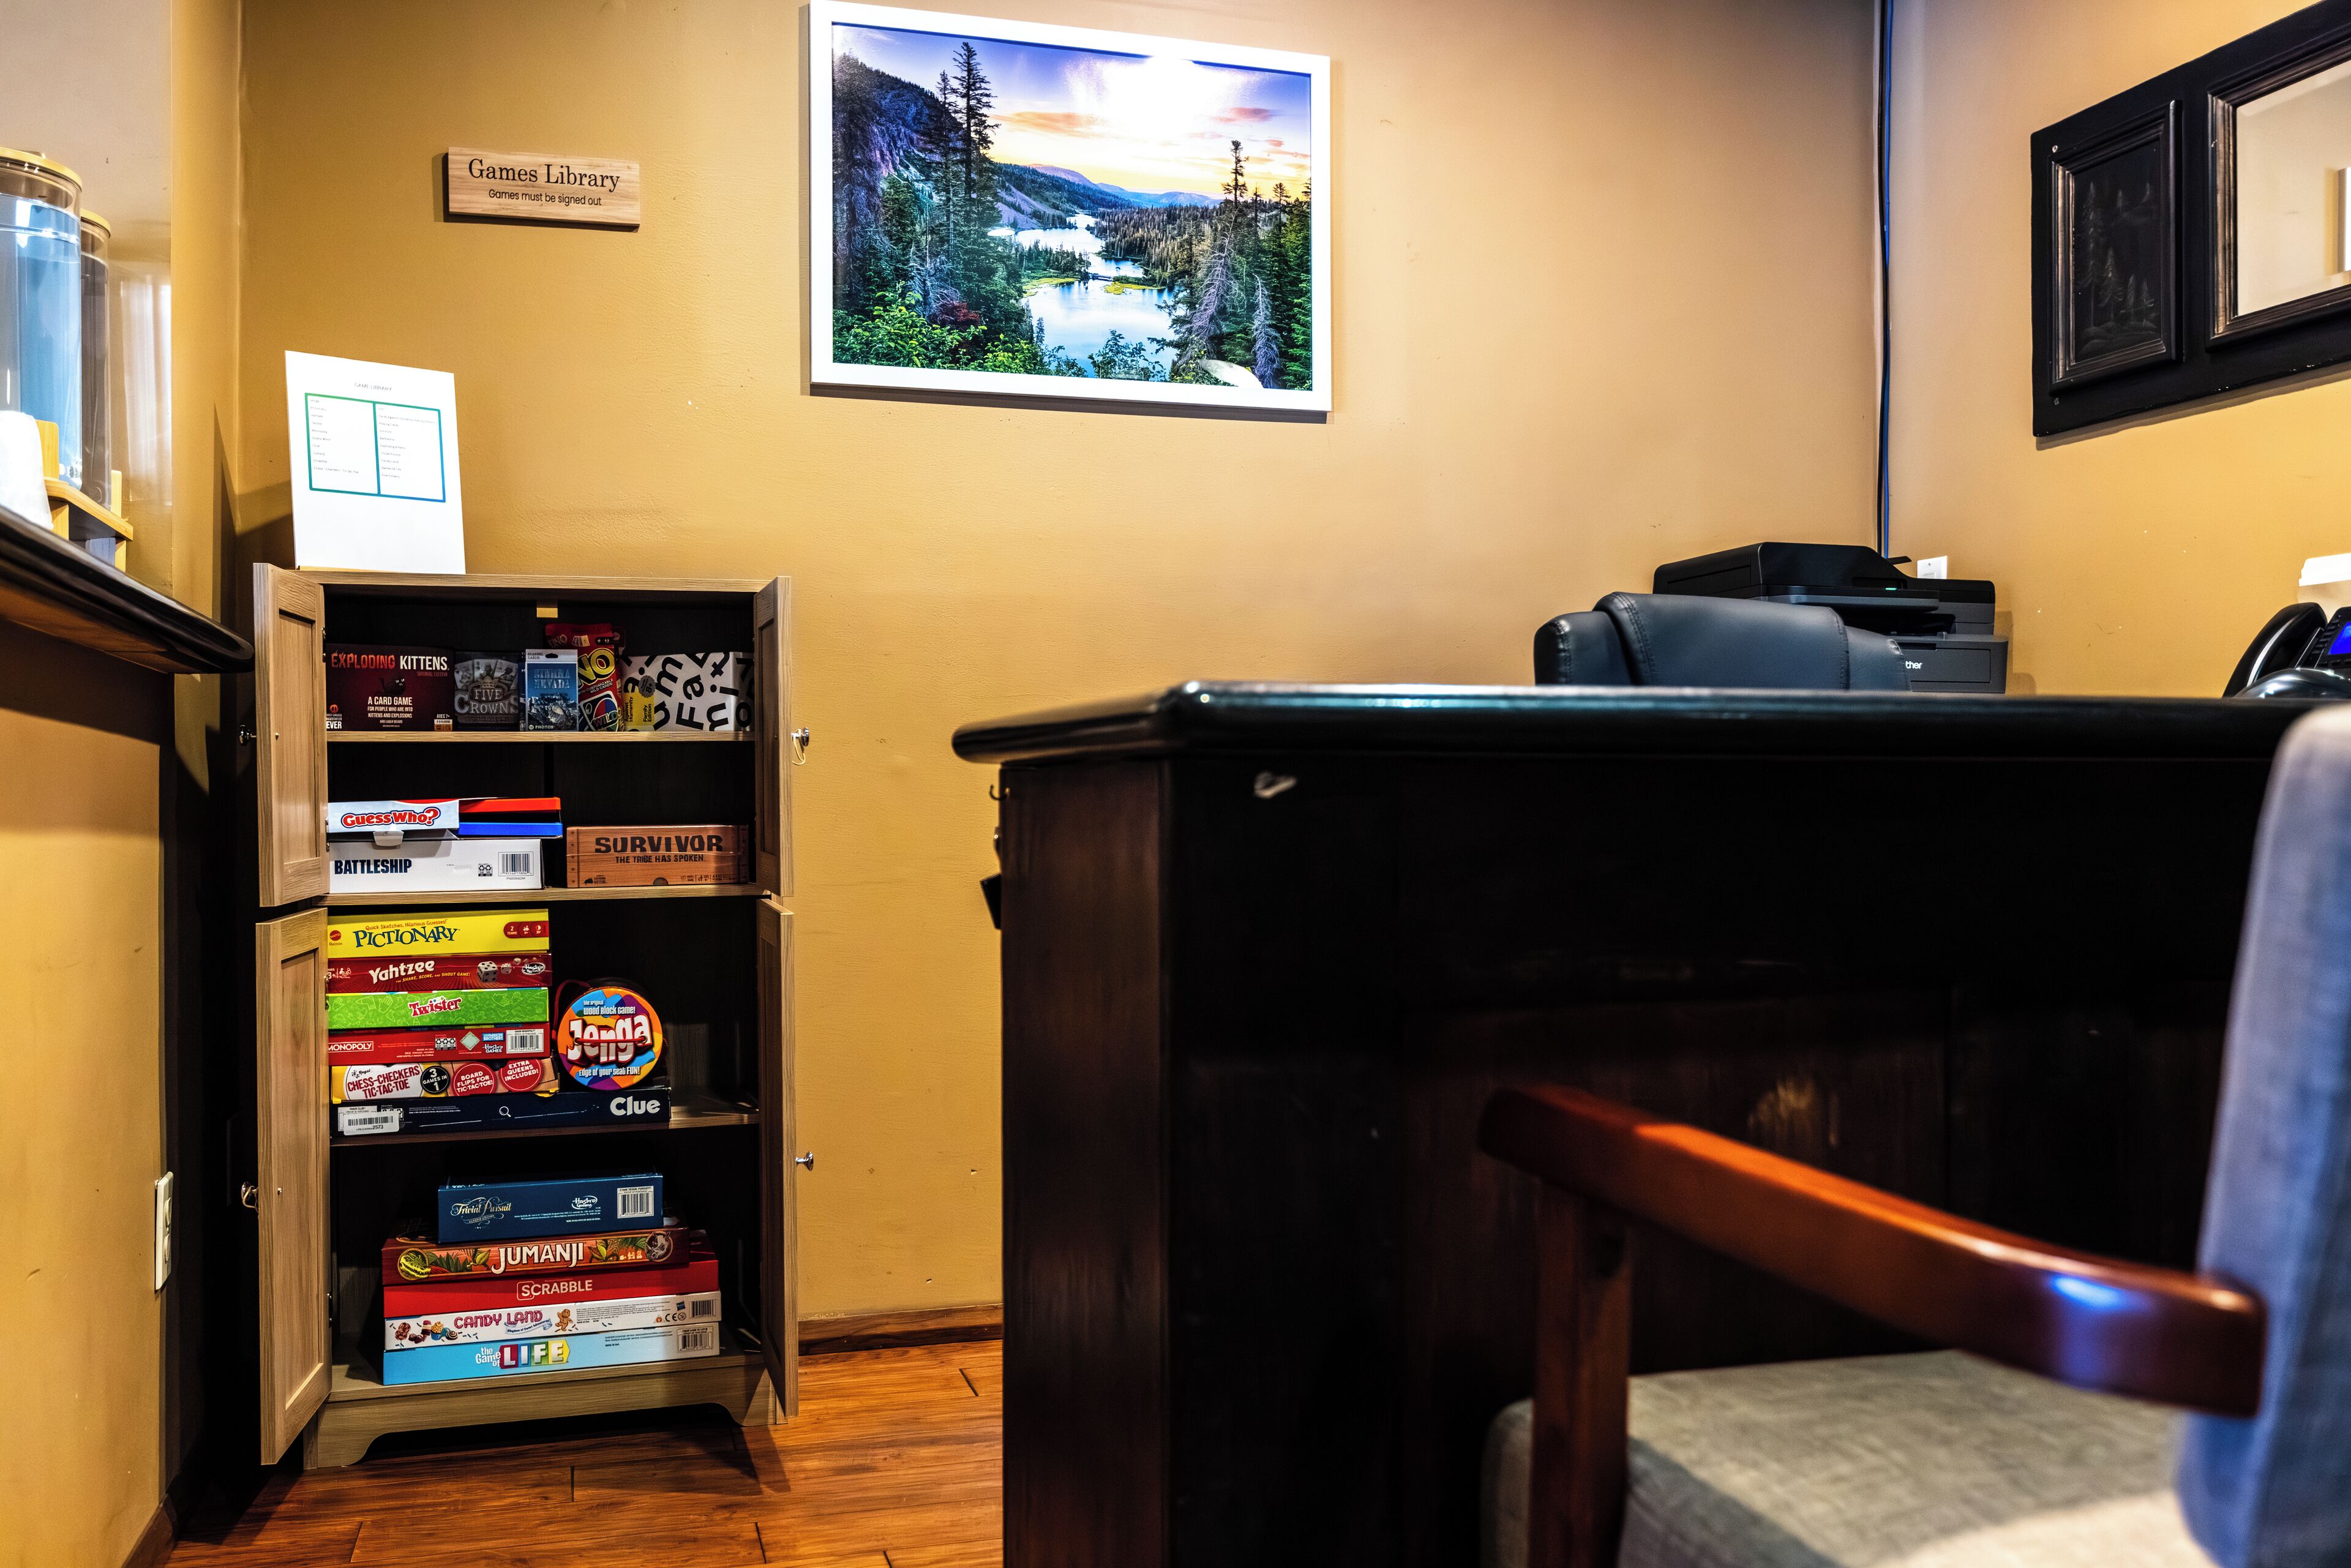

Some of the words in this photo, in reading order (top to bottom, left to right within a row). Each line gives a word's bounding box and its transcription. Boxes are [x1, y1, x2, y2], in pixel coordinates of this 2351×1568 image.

[468, 158, 538, 182] Games
[544, 163, 620, 193] Library
[489, 189, 519, 200] Games
[522, 193, 543, 201] must
[545, 192, 556, 203] be
[558, 194, 586, 206] signed
[588, 196, 602, 206] out
[331, 651, 395, 669] EXPLODING
[400, 656, 448, 670] KITTENS
[578, 649, 615, 681] NO
[1905, 661, 1922, 669] ther
[394, 697, 413, 705] GAME
[474, 689, 501, 700] FIVE
[341, 812, 391, 827] Guess
[391, 807, 441, 825] Who?
[594, 835, 723, 853] SURVIVOR
[334, 858, 411, 874] BATTLESHIP
[353, 926, 458, 948] PICTIONARY
[369, 960, 435, 985] Yahtzee
[408, 996, 462, 1017] Twister
[328, 1043, 372, 1051] MONOPOLY
[567, 1014, 653, 1064] Jenga
[429, 1068, 438, 1077] 3
[507, 1065, 534, 1075] QUEENS
[508, 1060, 530, 1069] EXTRA
[593, 1067, 598, 1076] of
[599, 1068, 612, 1078] your
[613, 1067, 626, 1076] seat
[457, 1078, 475, 1087] FLIPS
[460, 1071, 484, 1081] BOARD
[504, 1068, 539, 1081] INCLUDED!
[362, 1079, 410, 1098] TIC-TAC-TOE
[433, 1082, 439, 1091] 1
[456, 1080, 493, 1092] TIC-TAC-TOE!
[610, 1096, 661, 1116] Clue
[451, 1197, 486, 1216] Trivial
[481, 1196, 512, 1216] Pursuit
[491, 1242, 584, 1274] JUMANJI
[521, 1280, 593, 1297] SCRABBLE
[454, 1313, 502, 1329] CANDY
[507, 1310, 543, 1325] LAND
[475, 1351, 501, 1364] Game
[504, 1342, 564, 1366] LIFE
